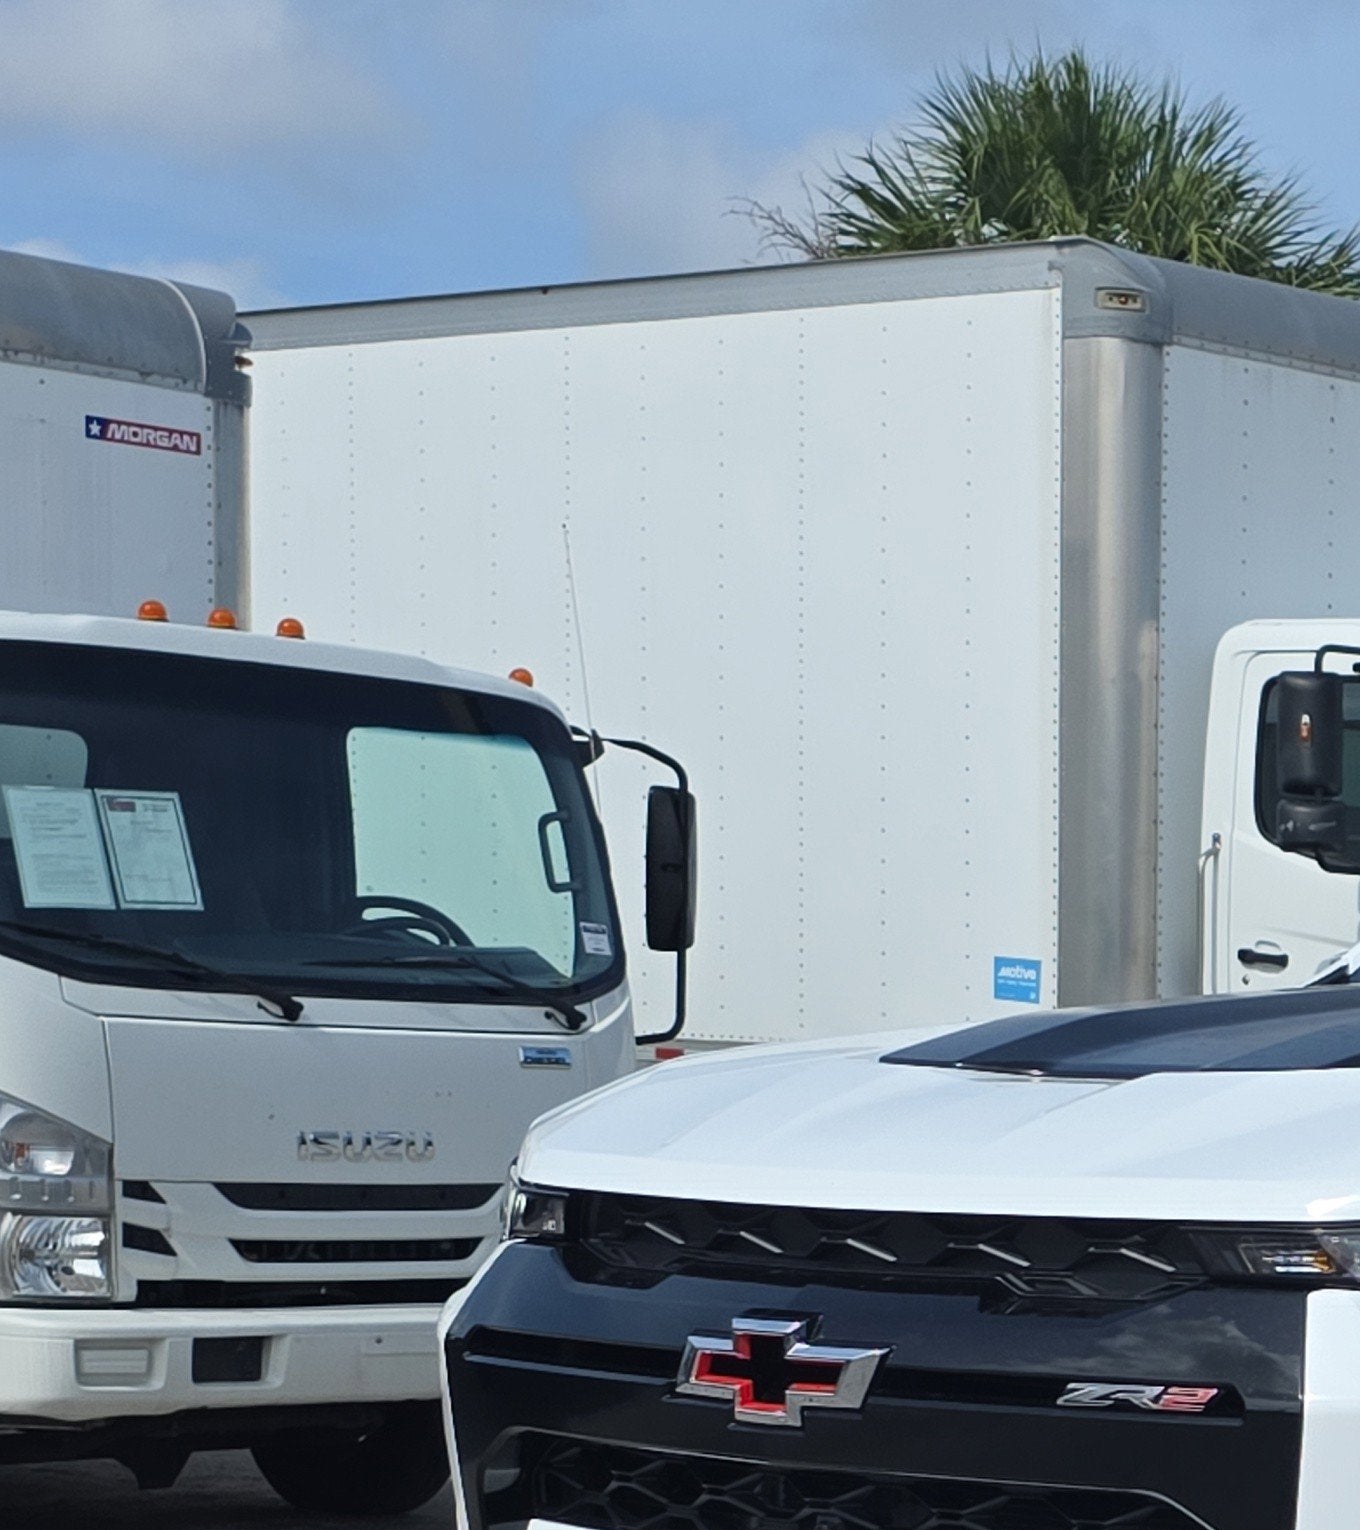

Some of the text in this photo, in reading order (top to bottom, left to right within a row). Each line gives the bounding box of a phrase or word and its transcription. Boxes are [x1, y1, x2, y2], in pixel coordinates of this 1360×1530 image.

[106, 423, 198, 452] MORGAN
[297, 1131, 435, 1163] ISUZU
[1056, 1382, 1219, 1412] ZR2
